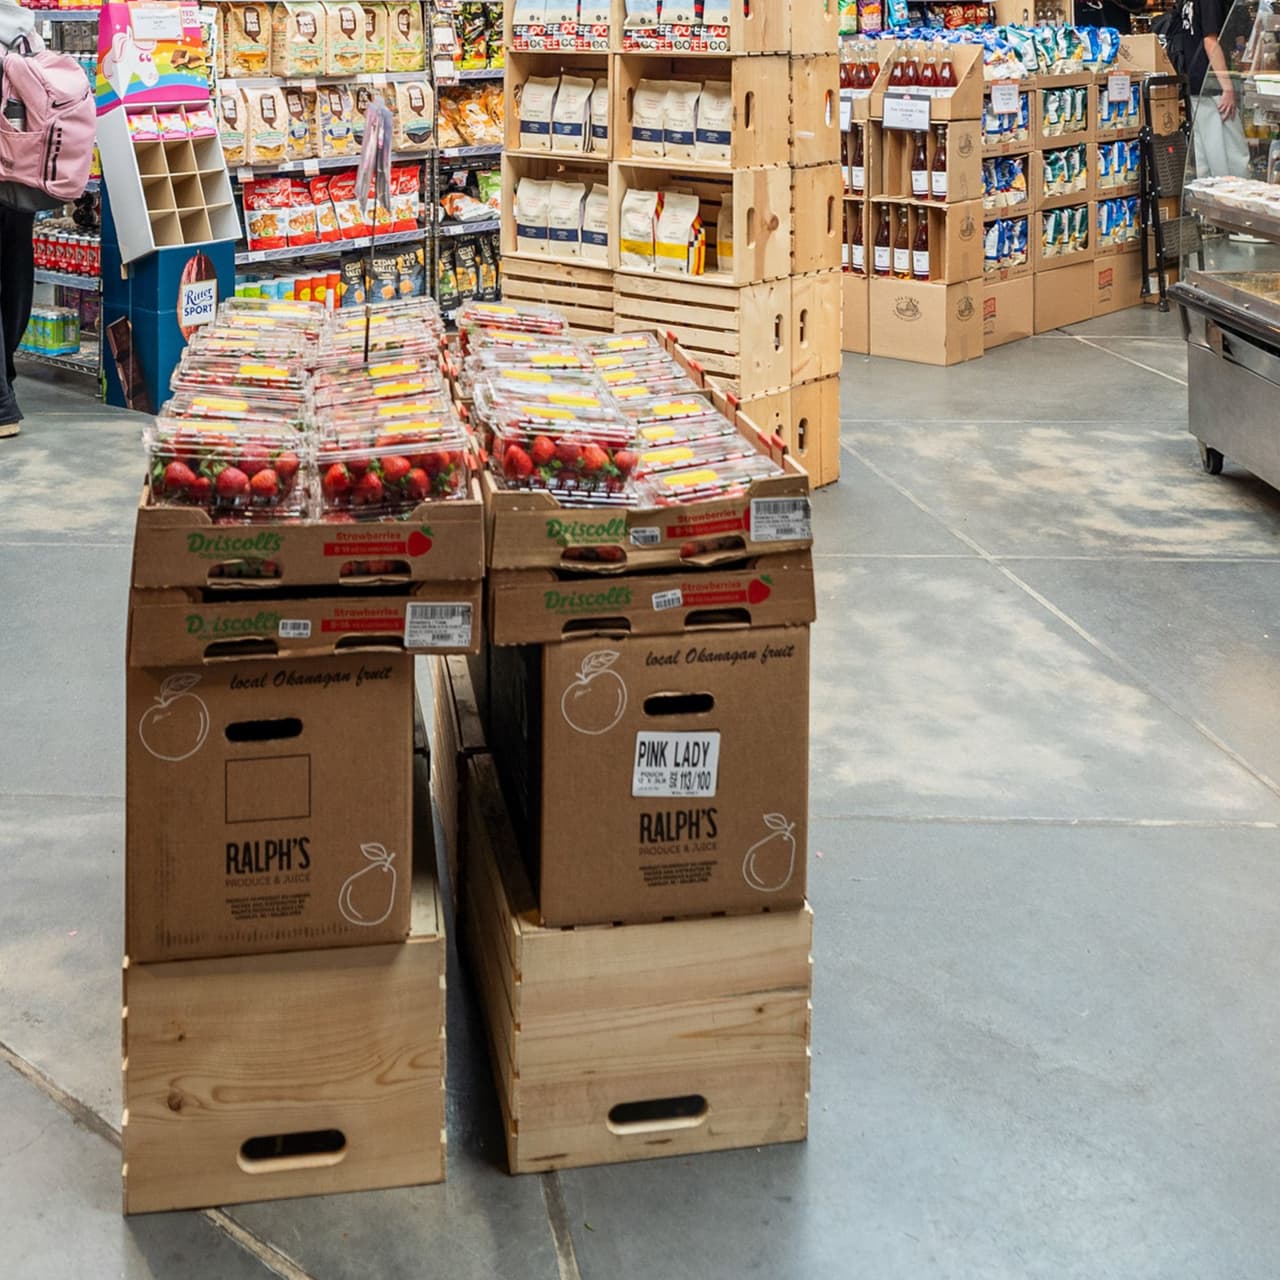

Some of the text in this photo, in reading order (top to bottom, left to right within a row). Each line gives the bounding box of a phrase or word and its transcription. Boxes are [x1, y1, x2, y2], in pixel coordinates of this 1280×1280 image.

[372, 258, 396, 267] CEDAR
[373, 265, 397, 273] VALLEY
[184, 286, 213, 305] Ritter
[184, 303, 213, 317] SPORT
[677, 509, 737, 523] Strawberries
[186, 531, 401, 554] Driscoll's Strawberries
[544, 580, 742, 609] Driscoll's Strawberries
[185, 608, 399, 635] Discoll's Strawberries
[645, 644, 794, 667] local Okanagan fruit
[230, 666, 393, 690] local Okanagan fruit
[638, 740, 710, 769] PINK LADY
[680, 771, 711, 791] 113/100
[639, 807, 718, 844] RALPH'S
[225, 836, 311, 875] RALPH'S
[639, 844, 680, 856] PRODUCE
[692, 841, 717, 853] JUICE
[225, 876, 271, 888] PRODUCE
[284, 872, 310, 884] JUICE
